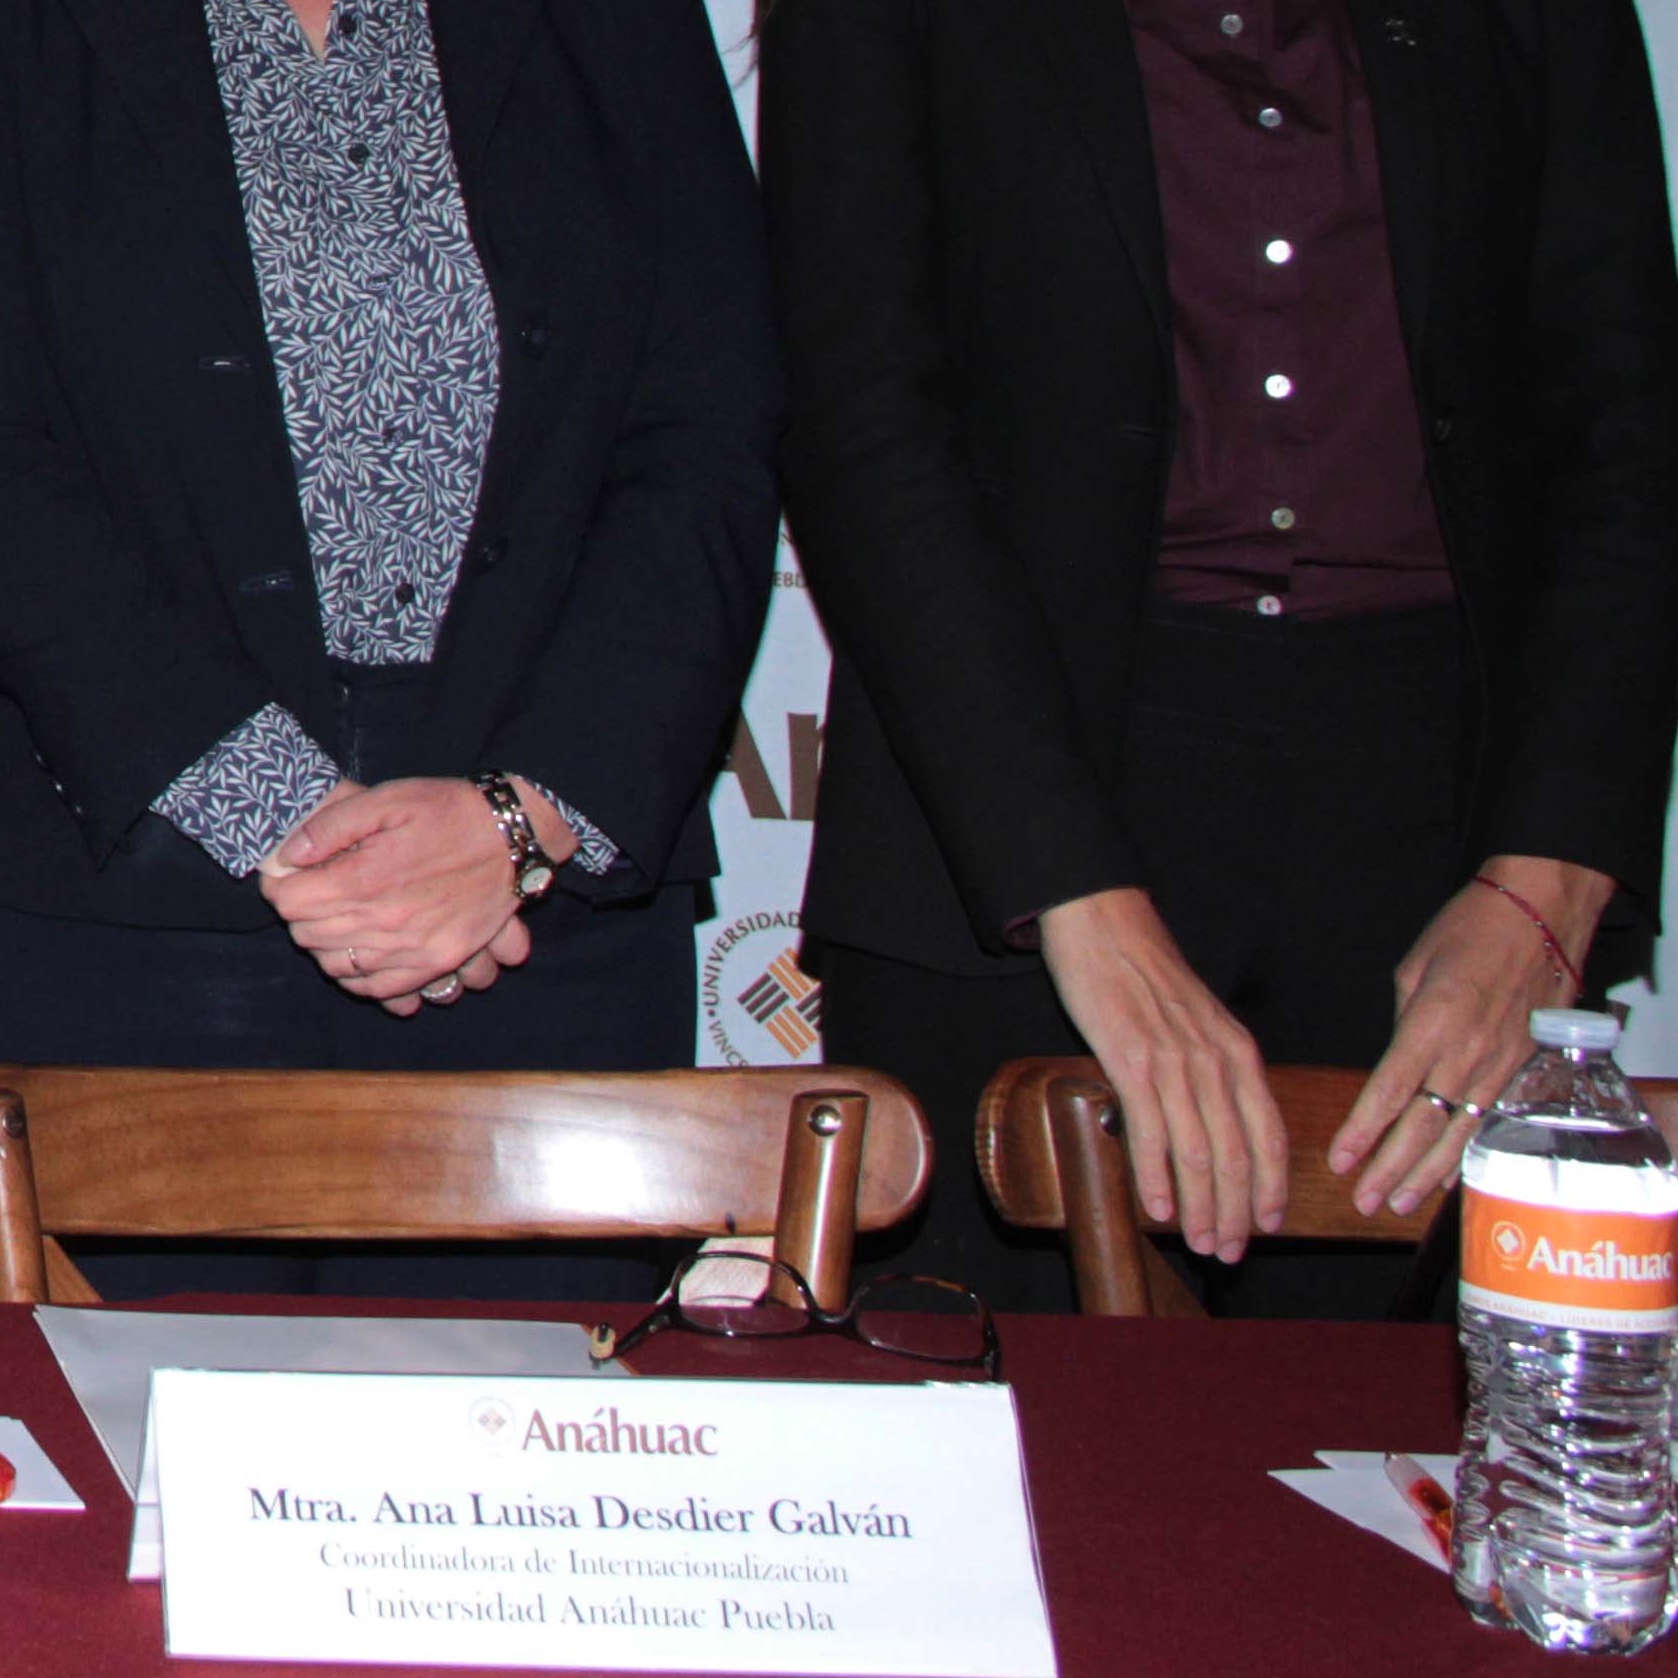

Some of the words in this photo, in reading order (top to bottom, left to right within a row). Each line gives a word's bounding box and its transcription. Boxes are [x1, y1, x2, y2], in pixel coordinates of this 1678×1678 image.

[1526, 1236, 1673, 1281] Anáhuac
[520, 1406, 719, 1456] Anáhuac
[248, 1487, 358, 1524] Mtra.
[373, 1491, 456, 1525] Ana
[470, 1492, 581, 1529] Luisa
[591, 1495, 754, 1534] Desdier
[768, 1498, 913, 1539] Galván
[318, 1543, 515, 1575] Coordinadora
[524, 1549, 558, 1574] de
[568, 1549, 851, 1584] Internacionalización
[344, 1588, 547, 1624] Universidad
[559, 1596, 708, 1629] Anáhuac
[719, 1599, 836, 1633] Puebla
